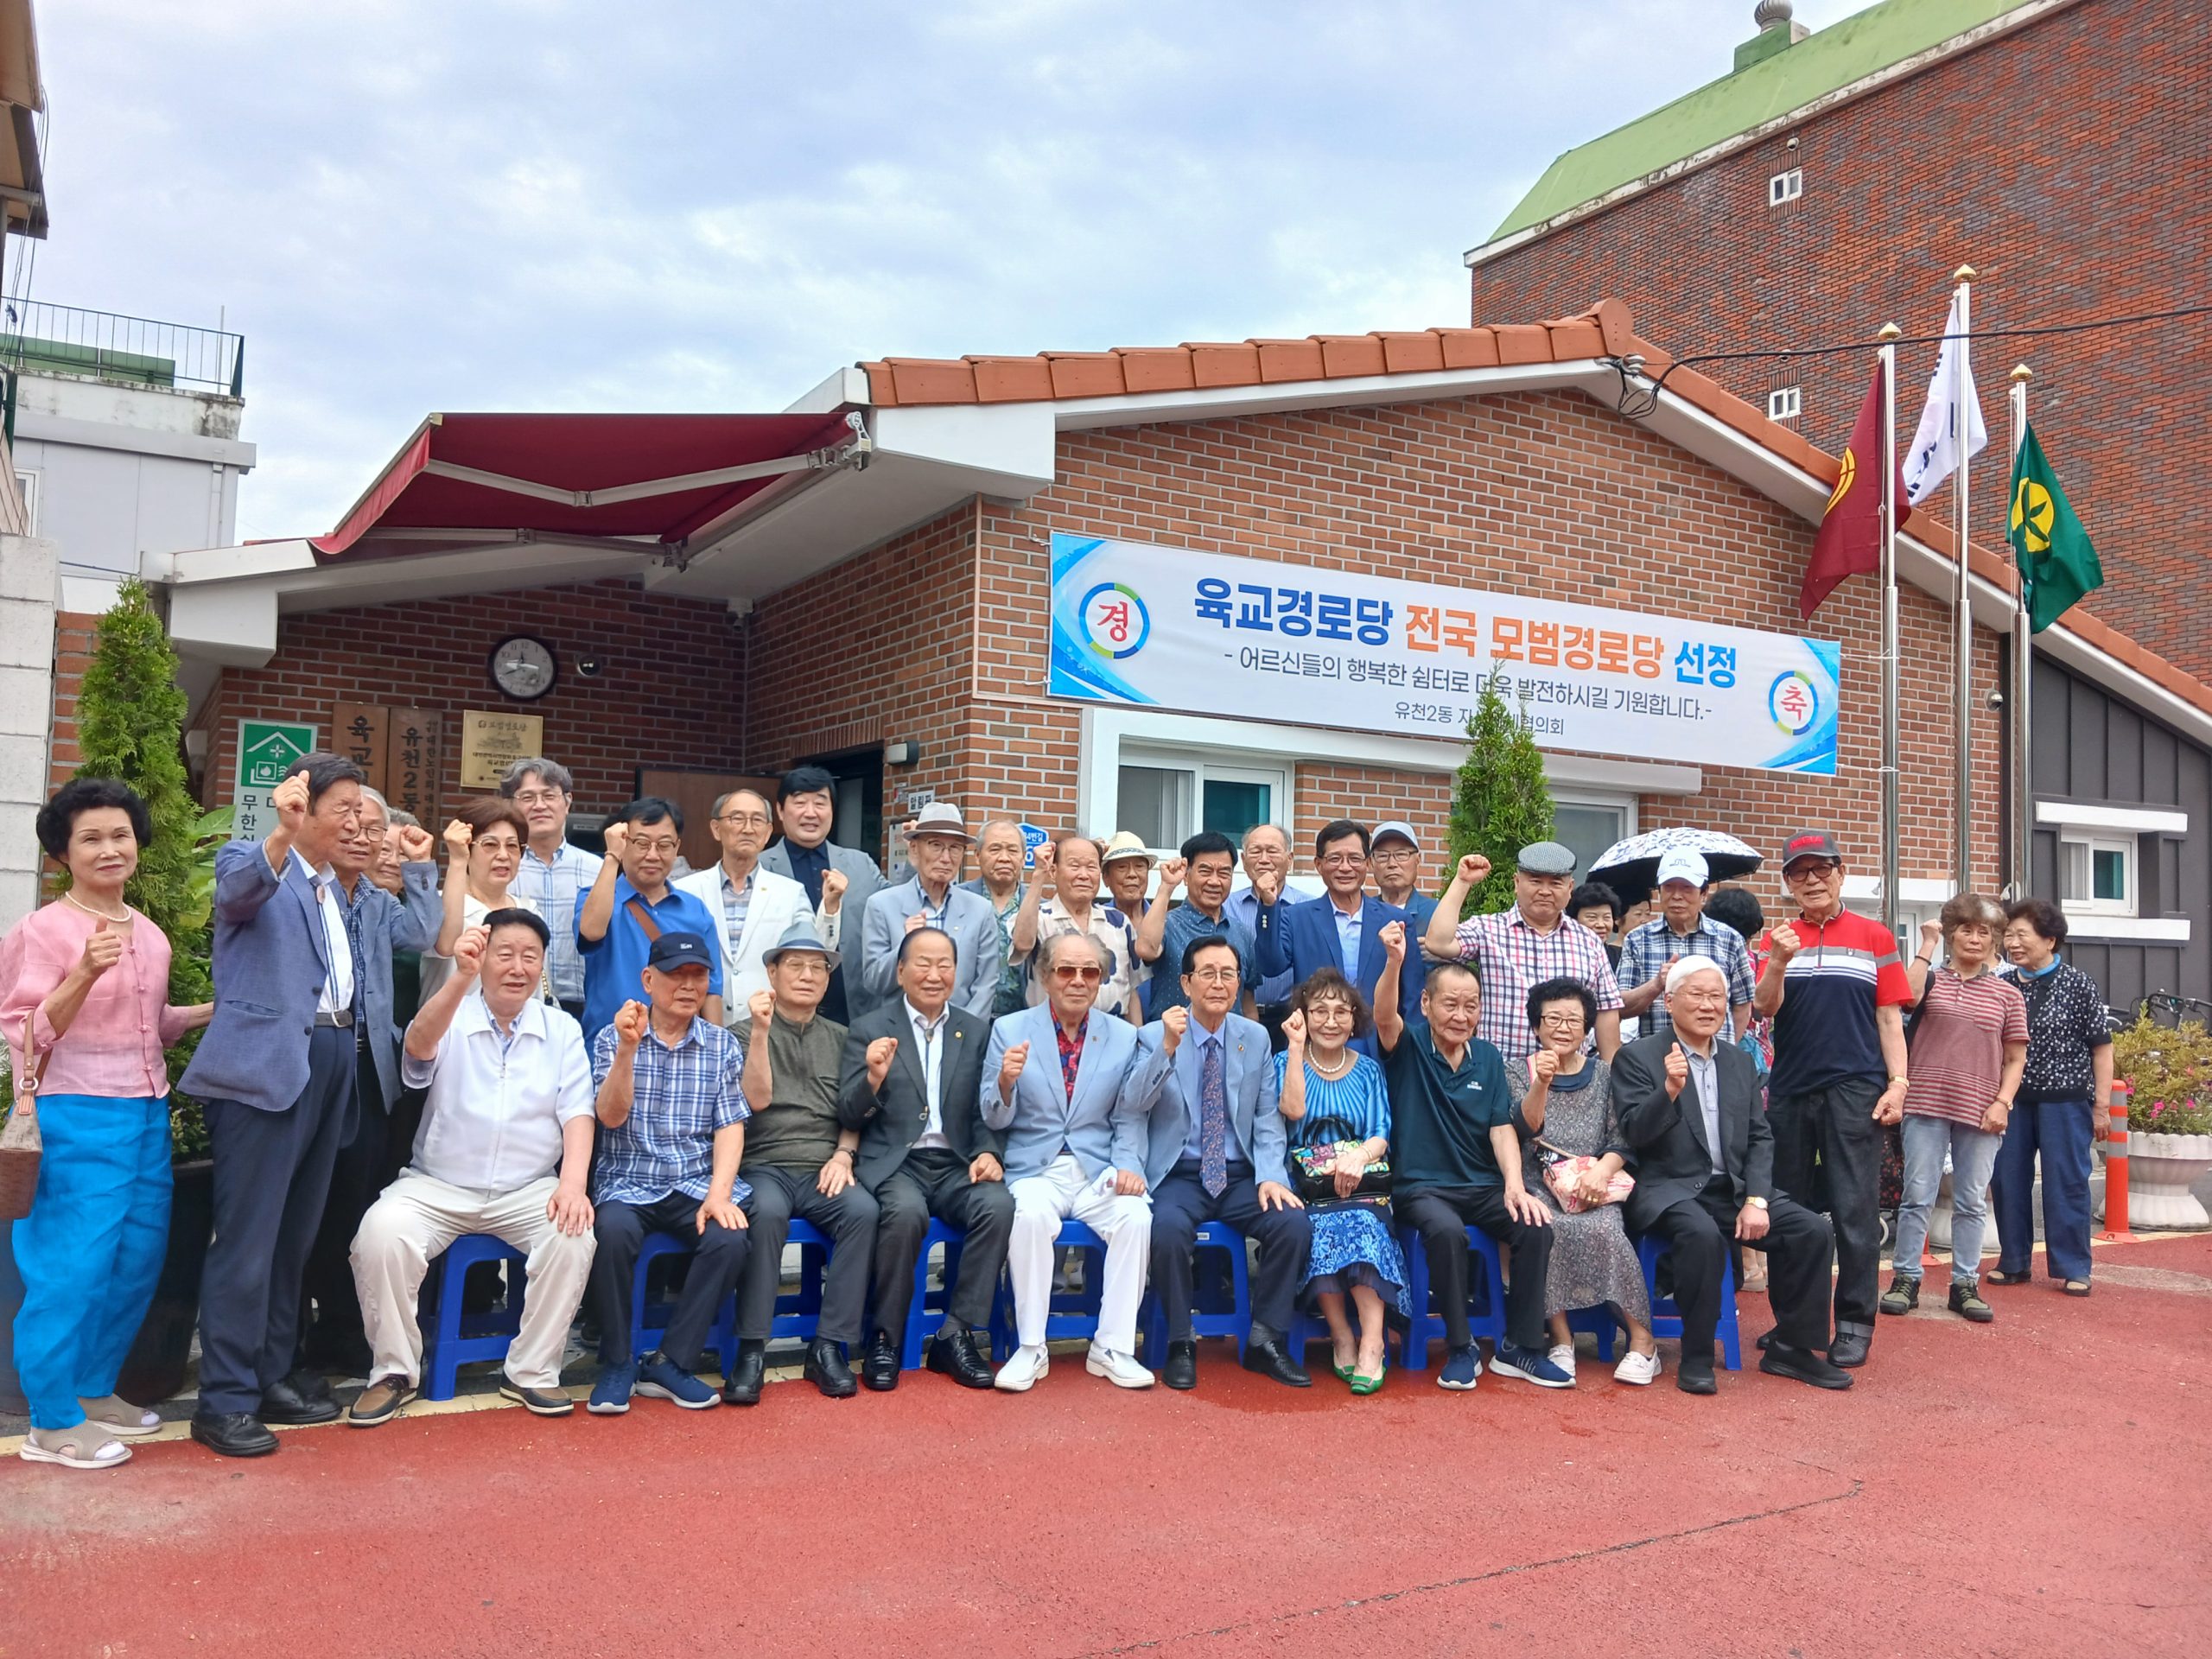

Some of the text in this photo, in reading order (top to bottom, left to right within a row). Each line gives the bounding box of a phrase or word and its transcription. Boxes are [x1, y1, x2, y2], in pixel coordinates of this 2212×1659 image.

[1096, 600, 1129, 643] 경
[1193, 576, 1737, 689] 육교경로당 전국 모범경로당 선정
[1239, 645, 1342, 680] 어르신들의
[1346, 658, 1408, 687] 행복한
[1411, 665, 1470, 694] 쉼터로
[1517, 677, 1609, 708] 발전하시길
[1780, 684, 1808, 722] 축
[1394, 701, 1453, 724] 유천2동
[398, 727, 424, 812] 유천2동
